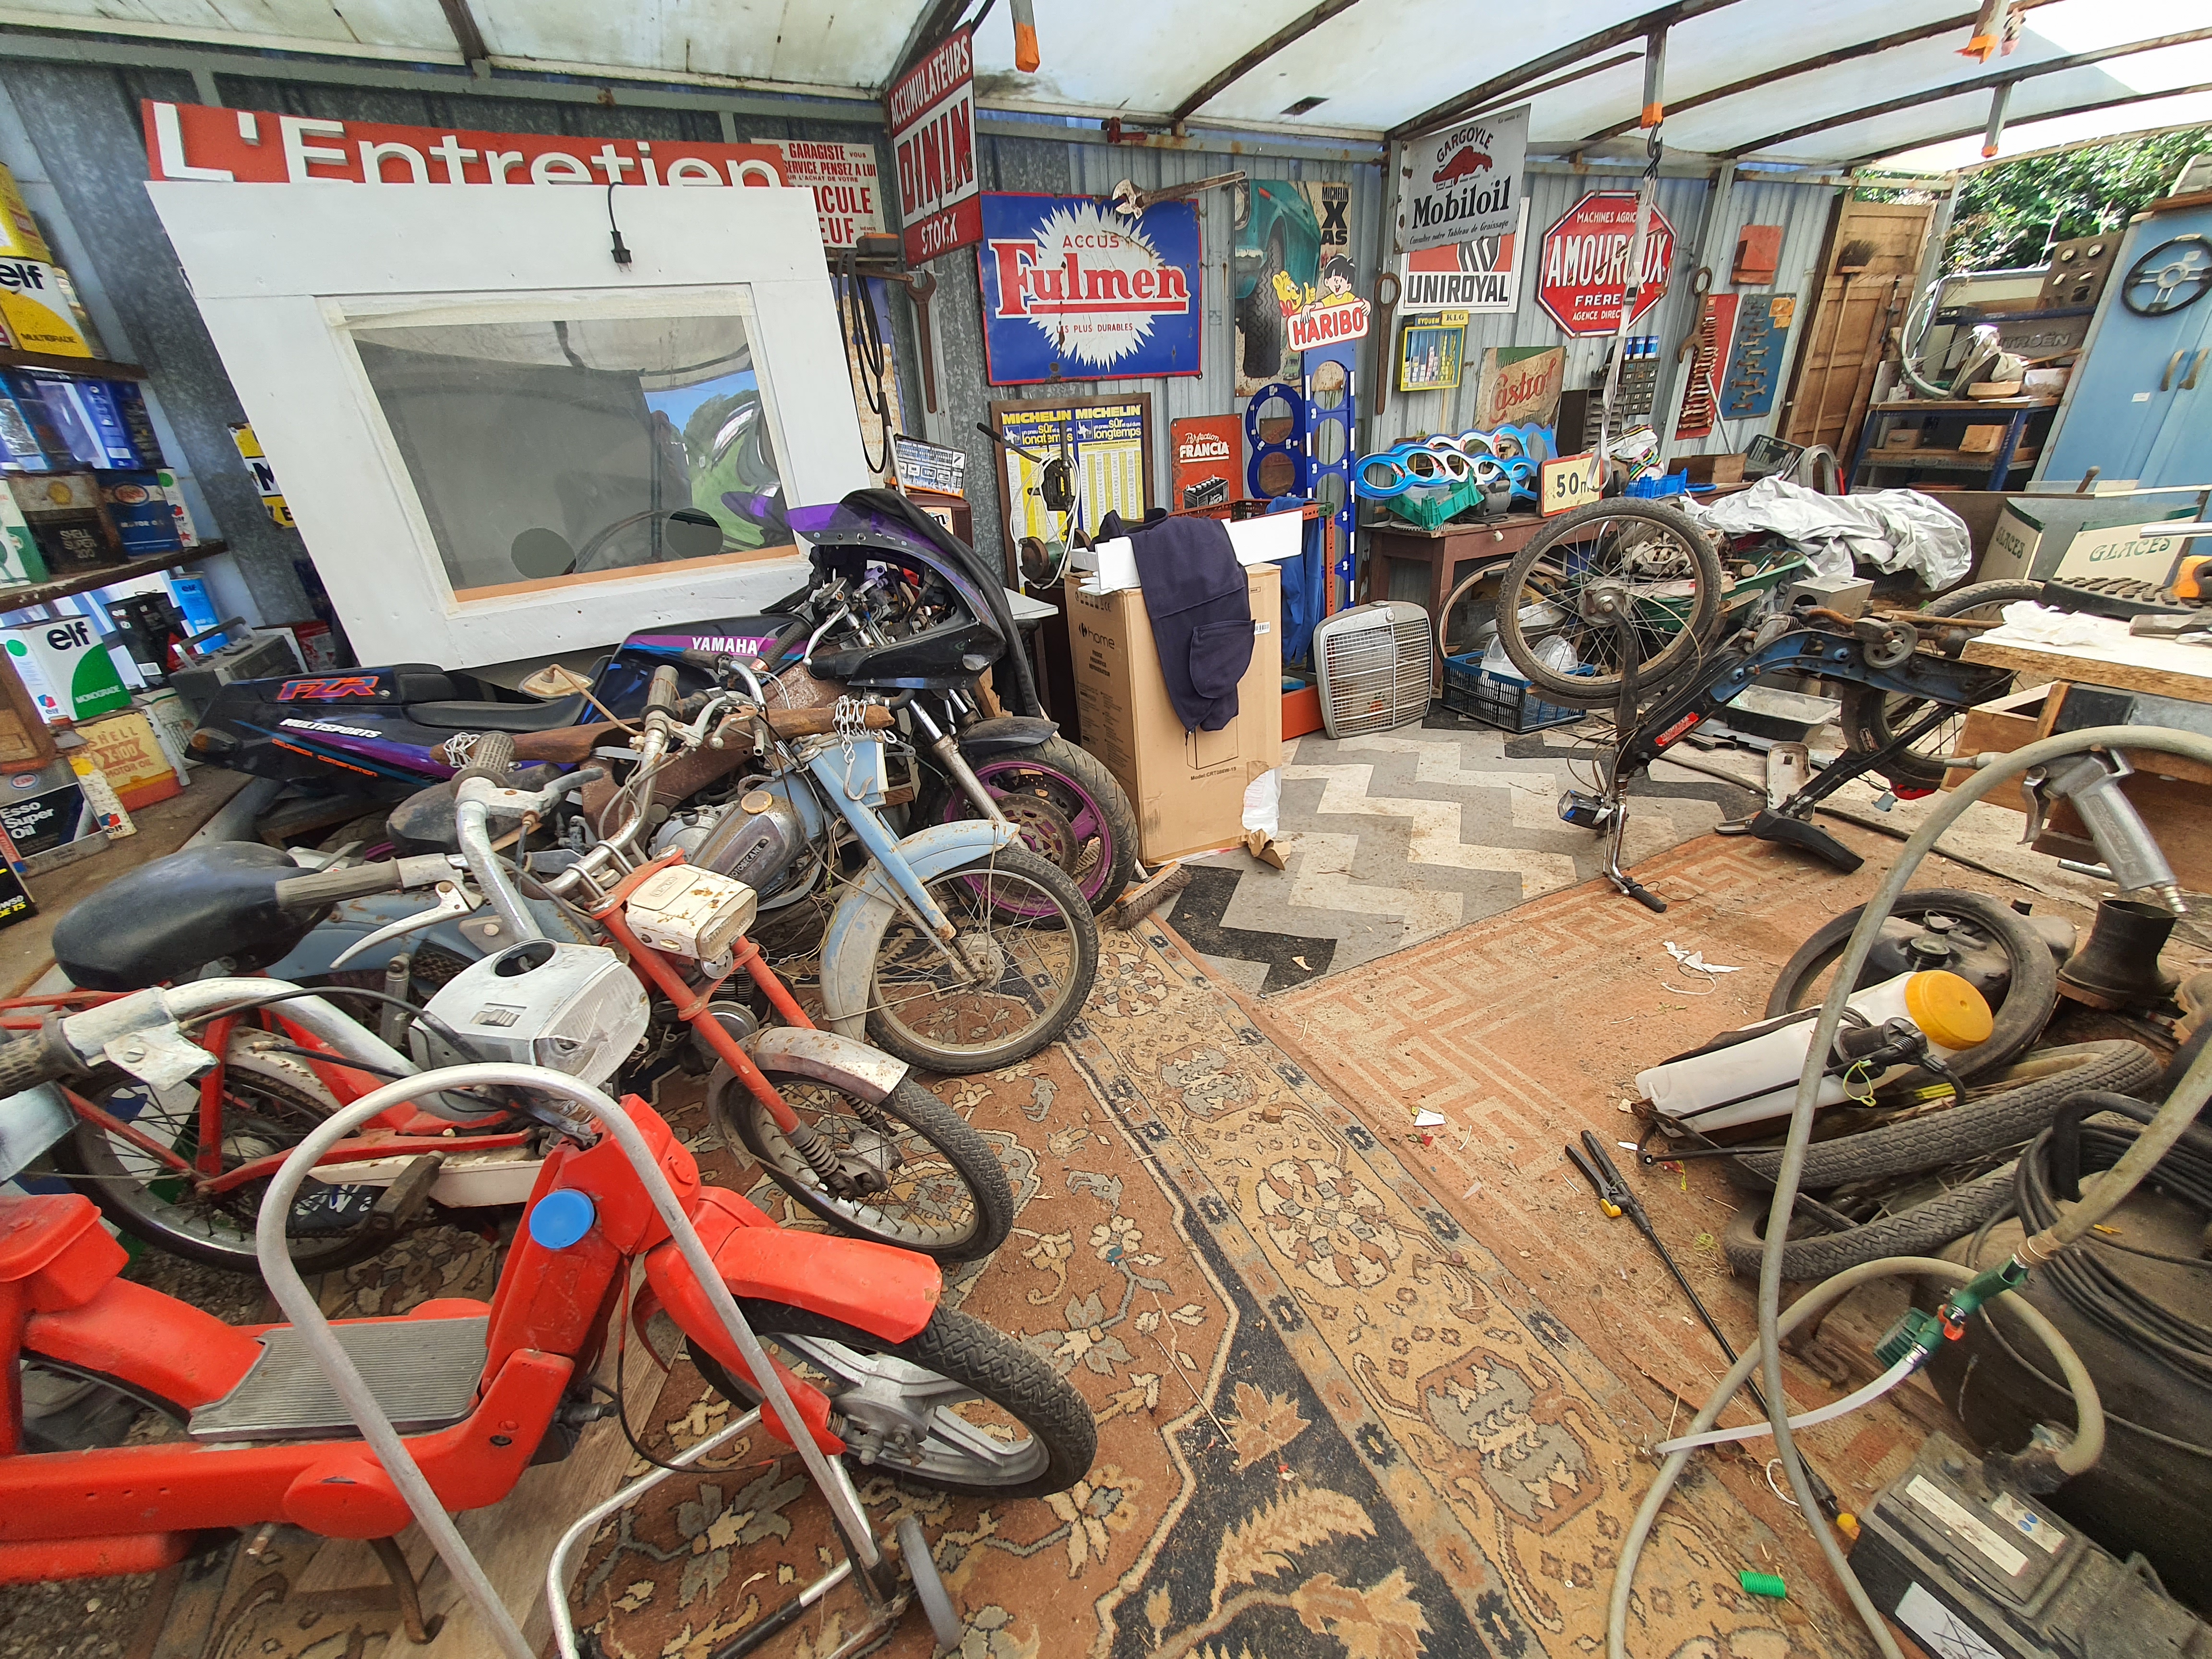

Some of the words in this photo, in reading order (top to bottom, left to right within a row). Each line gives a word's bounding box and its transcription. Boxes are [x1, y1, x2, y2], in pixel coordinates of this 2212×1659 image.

[890, 35, 970, 129] ACCUMULATEURS
[153, 101, 782, 187] L'Entretien
[1437, 126, 1494, 163] GARGOYLE
[897, 96, 974, 216] DININ
[820, 162, 853, 176] PENSEZ
[855, 163, 862, 176] A
[863, 163, 877, 177] LUI
[812, 185, 874, 214] ICULE
[1322, 186, 1349, 201] MICHELIN
[1412, 174, 1512, 229] Mobiloil
[1322, 200, 1348, 229] X
[1576, 211, 1614, 224] MACHINES
[1615, 212, 1637, 224] AGRIC
[819, 217, 854, 244] EUF
[921, 212, 958, 256] STOCK
[1321, 230, 1347, 245] AS
[1447, 226, 1469, 238] Tableau
[1471, 223, 1478, 232] de
[1480, 219, 1509, 231] Graissage
[1062, 235, 1119, 249] ACCUS
[0, 263, 44, 291] elf
[990, 241, 1190, 317] Fulmen
[1407, 274, 1508, 303] UNIROYAL
[1572, 311, 1598, 321] AGENCE
[1073, 325, 1093, 333] PLUS
[1097, 323, 1133, 332] DURABLES
[1293, 308, 1364, 346] HARIBO
[20, 333, 77, 344] MULTIGRADE
[2001, 332, 2072, 349] ITROËN
[1489, 357, 1557, 423] Castrol
[1002, 409, 1072, 425] MICHELIN
[1075, 405, 1142, 420] MICHELIN
[1038, 423, 1054, 434] sûr
[1108, 418, 1123, 429] sûr
[1022, 433, 1073, 445] longtems
[1093, 427, 1142, 440] longtemps
[1185, 432, 1220, 445] Perfection
[1179, 441, 1230, 458] FRANCIA
[1996, 526, 2026, 559] GLACES
[2089, 537, 2174, 562] GLACES
[47, 621, 89, 651] elf
[1087, 626, 1115, 650] home
[691, 637, 758, 656] YAMAHA
[74, 684, 121, 704] MONOGRADE
[277, 675, 380, 700] FZR
[45, 706, 60, 715] elf
[88, 726, 138, 748] SHELL
[278, 718, 383, 738] MULTISPORTS
[104, 762, 138, 778] MOTOR
[139, 759, 154, 768] OIL
[0, 802, 41, 819] Esso
[4, 808, 55, 829] Super
[11, 825, 37, 839] Oil
[106, 825, 123, 833] elf
[0, 895, 24, 910] W50
